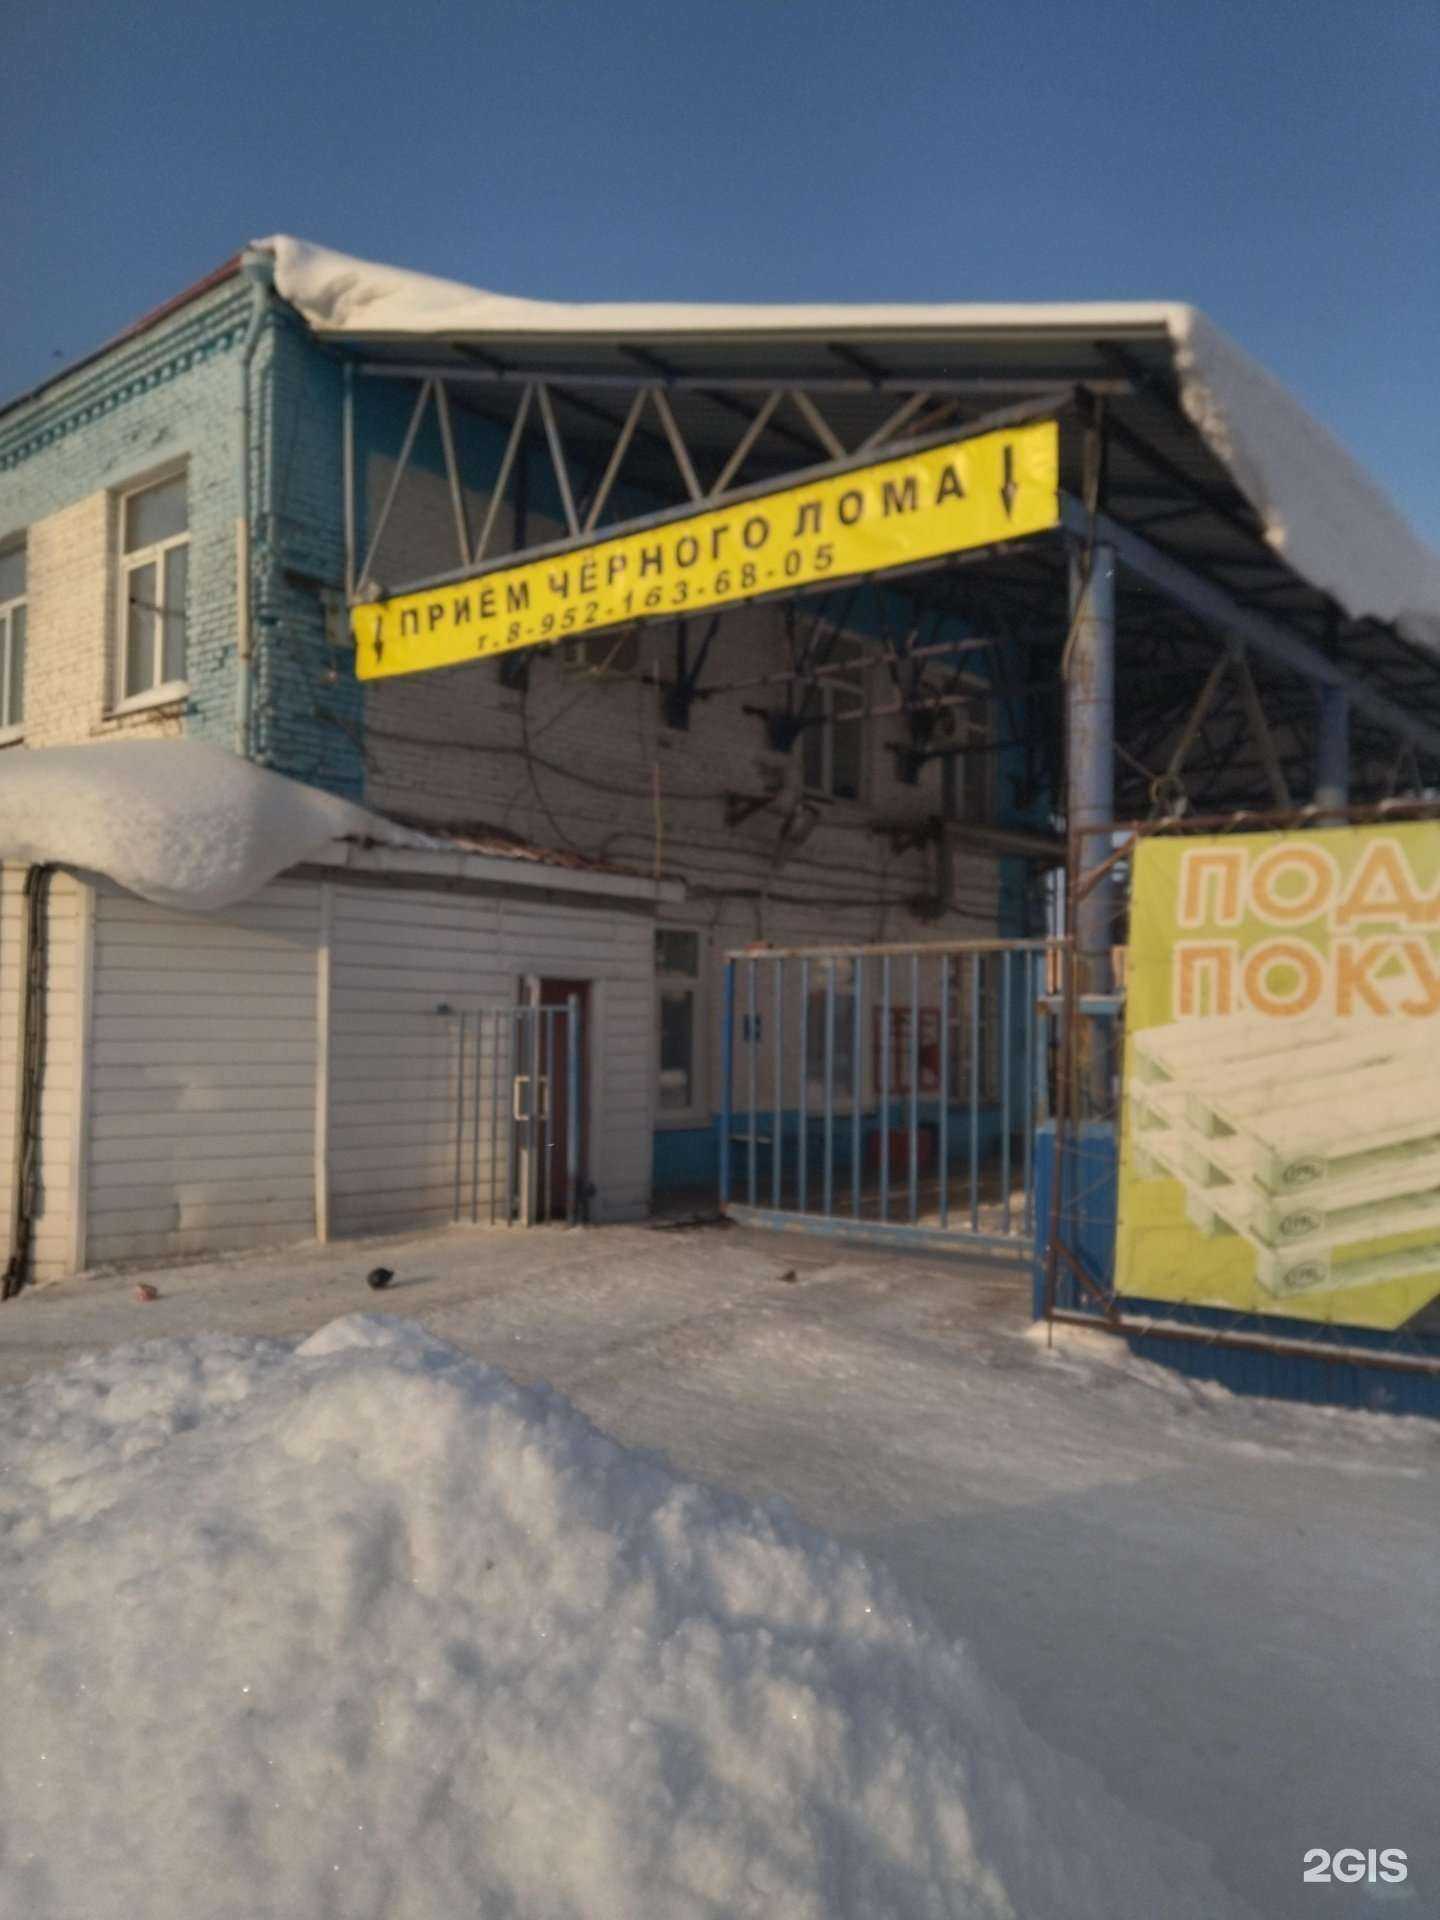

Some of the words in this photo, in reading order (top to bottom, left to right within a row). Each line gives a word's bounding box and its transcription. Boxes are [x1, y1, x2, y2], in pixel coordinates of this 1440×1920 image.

[548, 514, 770, 598] ЧЁРНОГО
[794, 464, 966, 537] ЛОМА
[1178, 839, 1440, 932] ПОД
